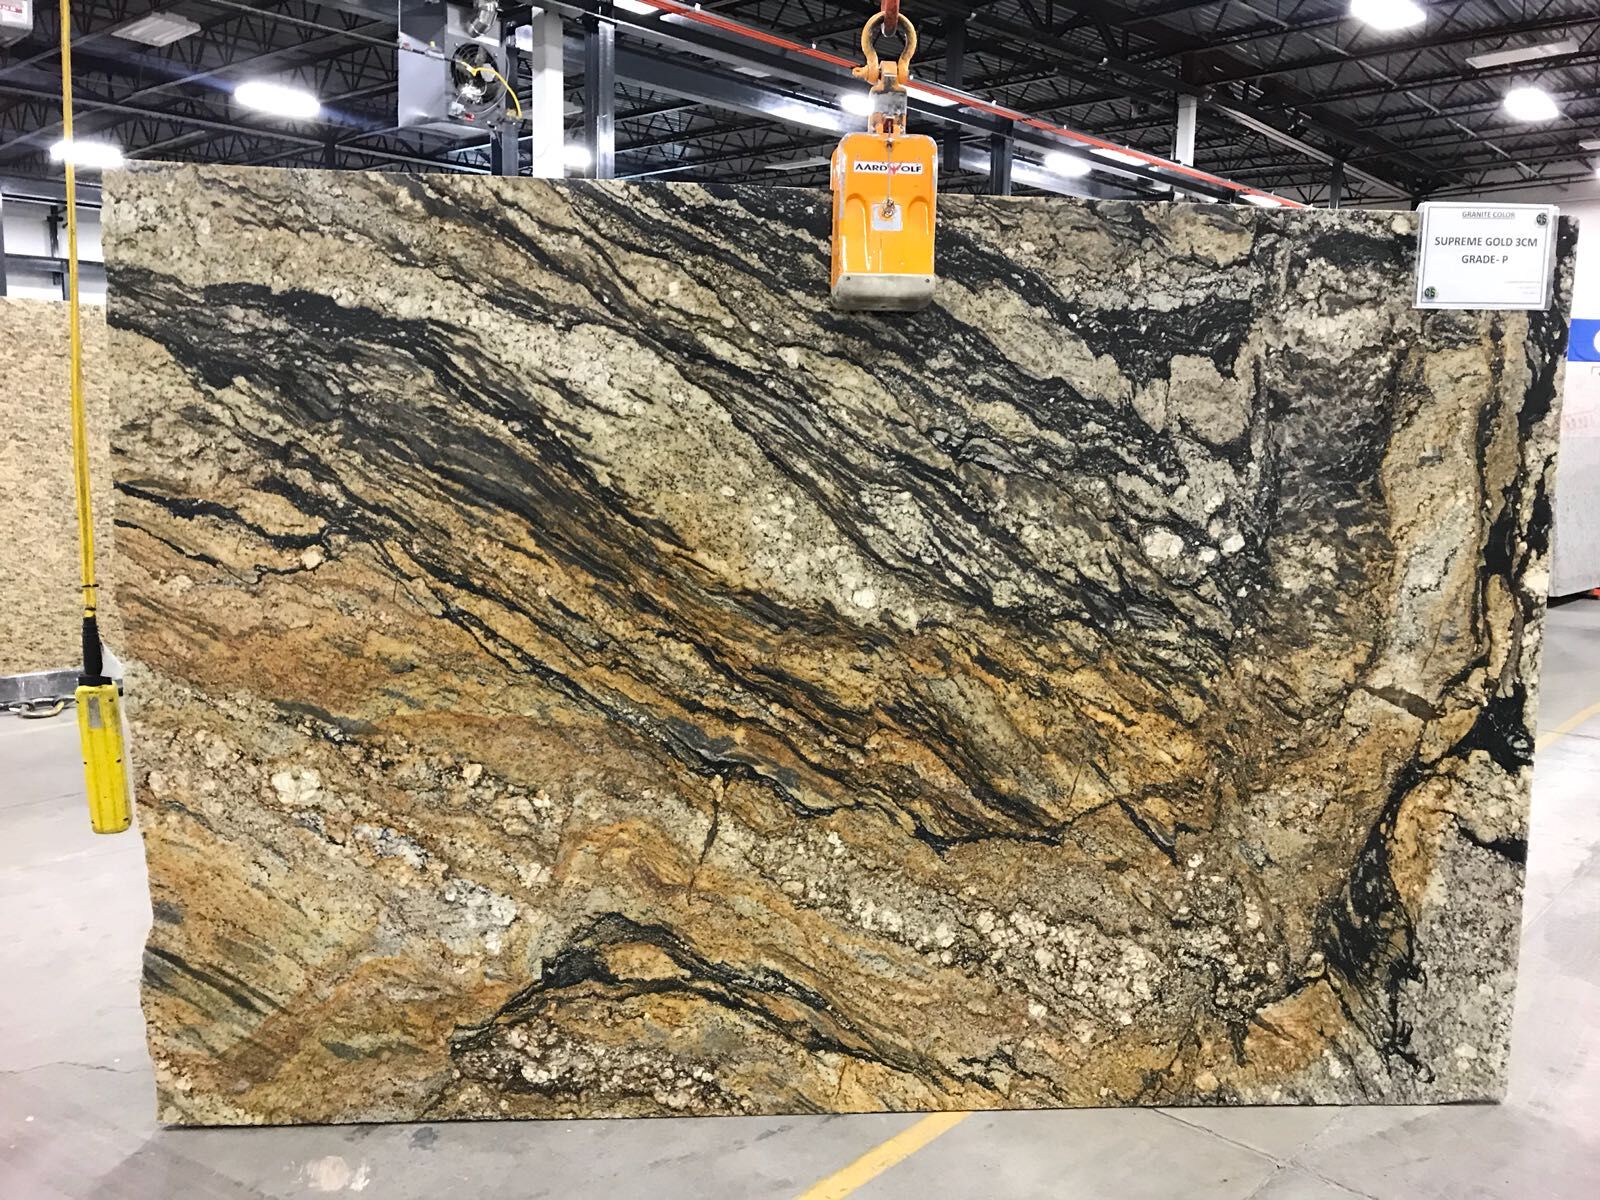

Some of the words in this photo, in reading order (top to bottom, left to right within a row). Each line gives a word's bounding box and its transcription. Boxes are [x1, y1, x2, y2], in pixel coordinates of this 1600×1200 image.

[1434, 236, 1482, 246] SUPREME
[1485, 237, 1513, 247] GOLD
[1515, 237, 1538, 247] 3CM
[1461, 254, 1500, 264] GRADE-
[1502, 255, 1509, 264] P
